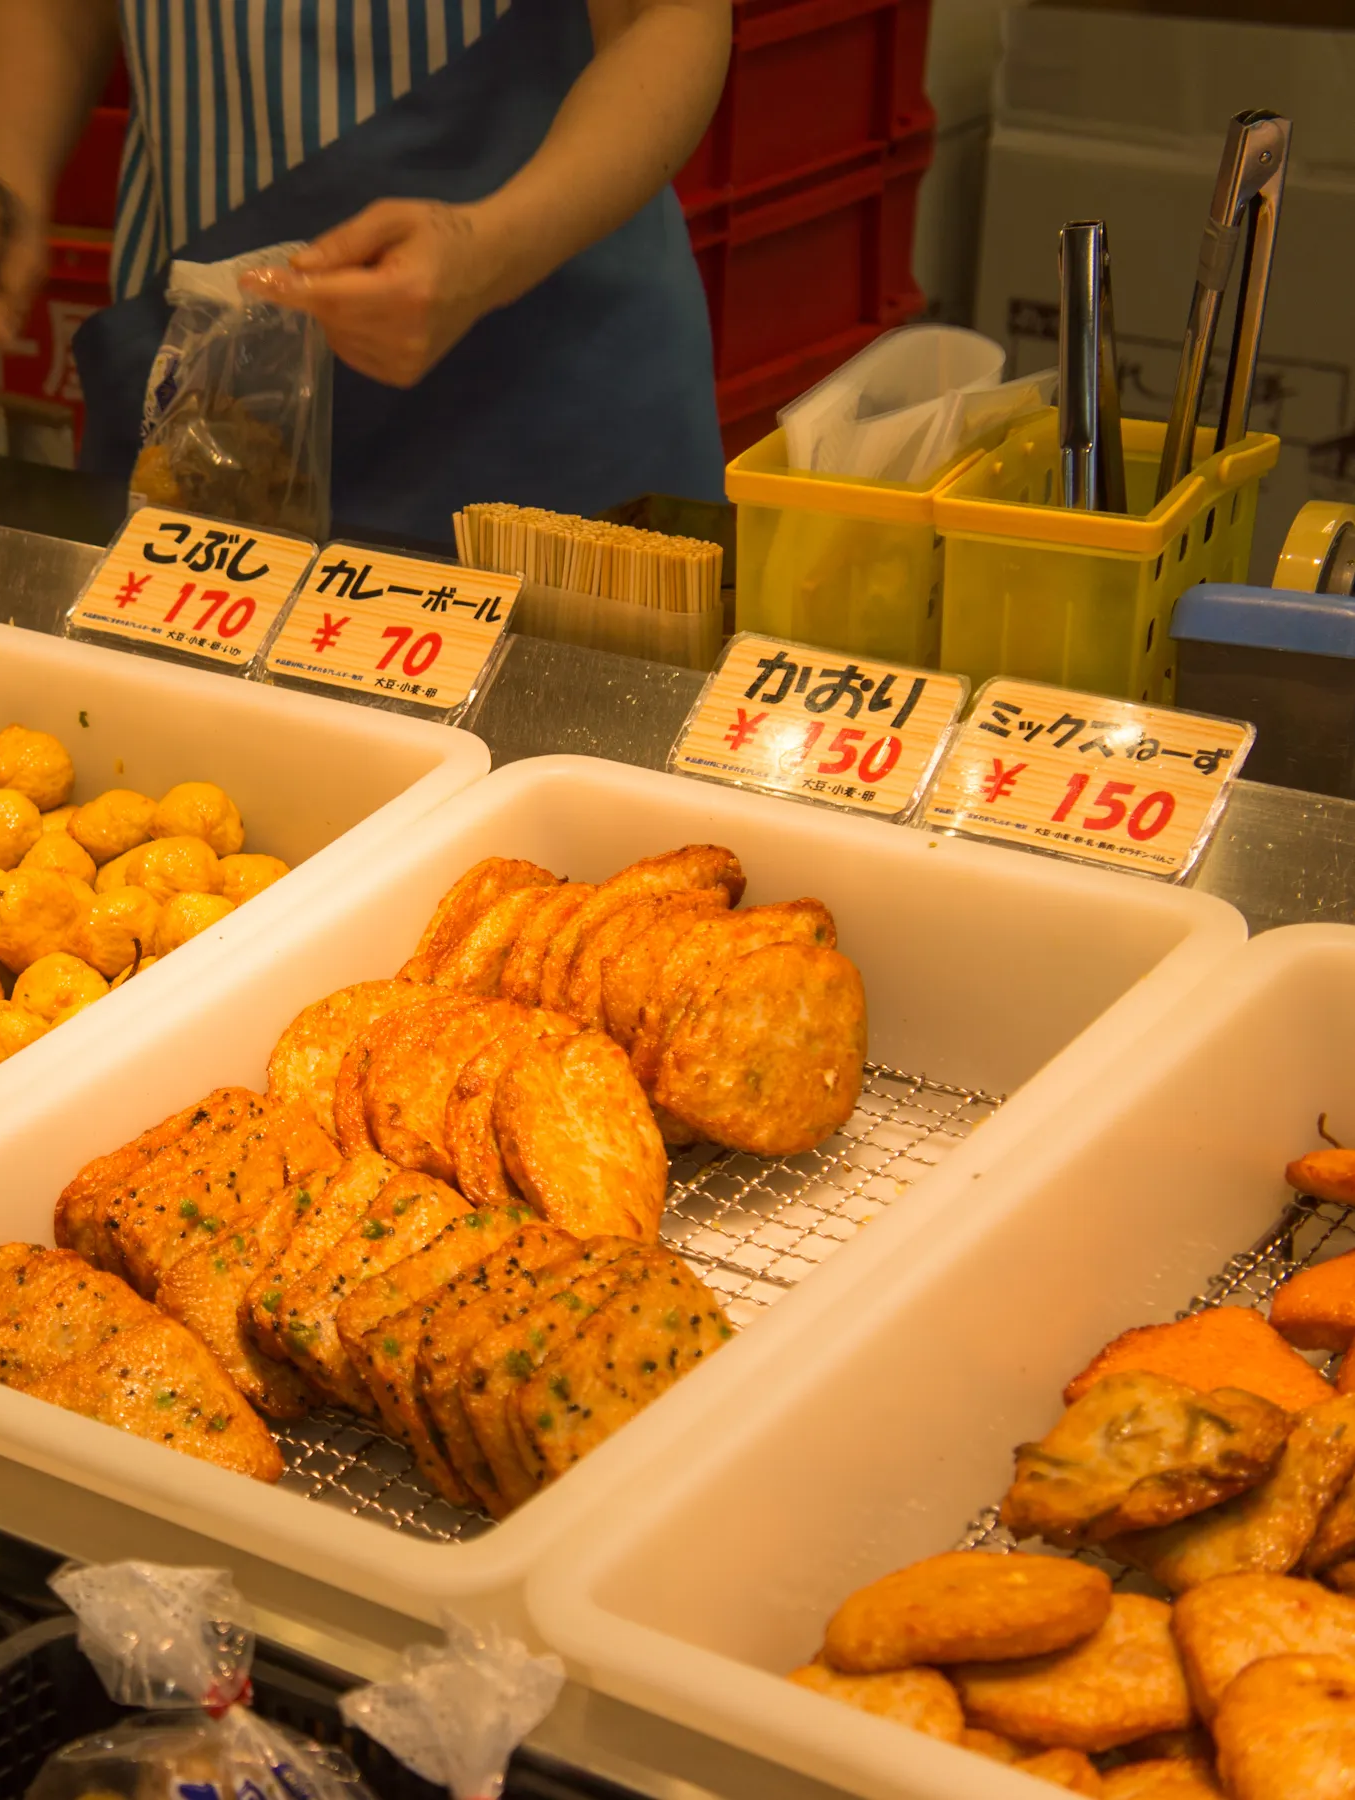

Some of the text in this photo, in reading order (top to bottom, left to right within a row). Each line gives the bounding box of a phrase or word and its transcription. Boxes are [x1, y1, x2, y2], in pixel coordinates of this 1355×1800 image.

[142, 522, 270, 582] こぶし
[163, 582, 256, 638] 170
[315, 559, 502, 623] カレーボール
[375, 626, 442, 677] 70
[744, 651, 927, 729] かおり
[791, 720, 903, 784] 150
[1050, 772, 1176, 842] 150
